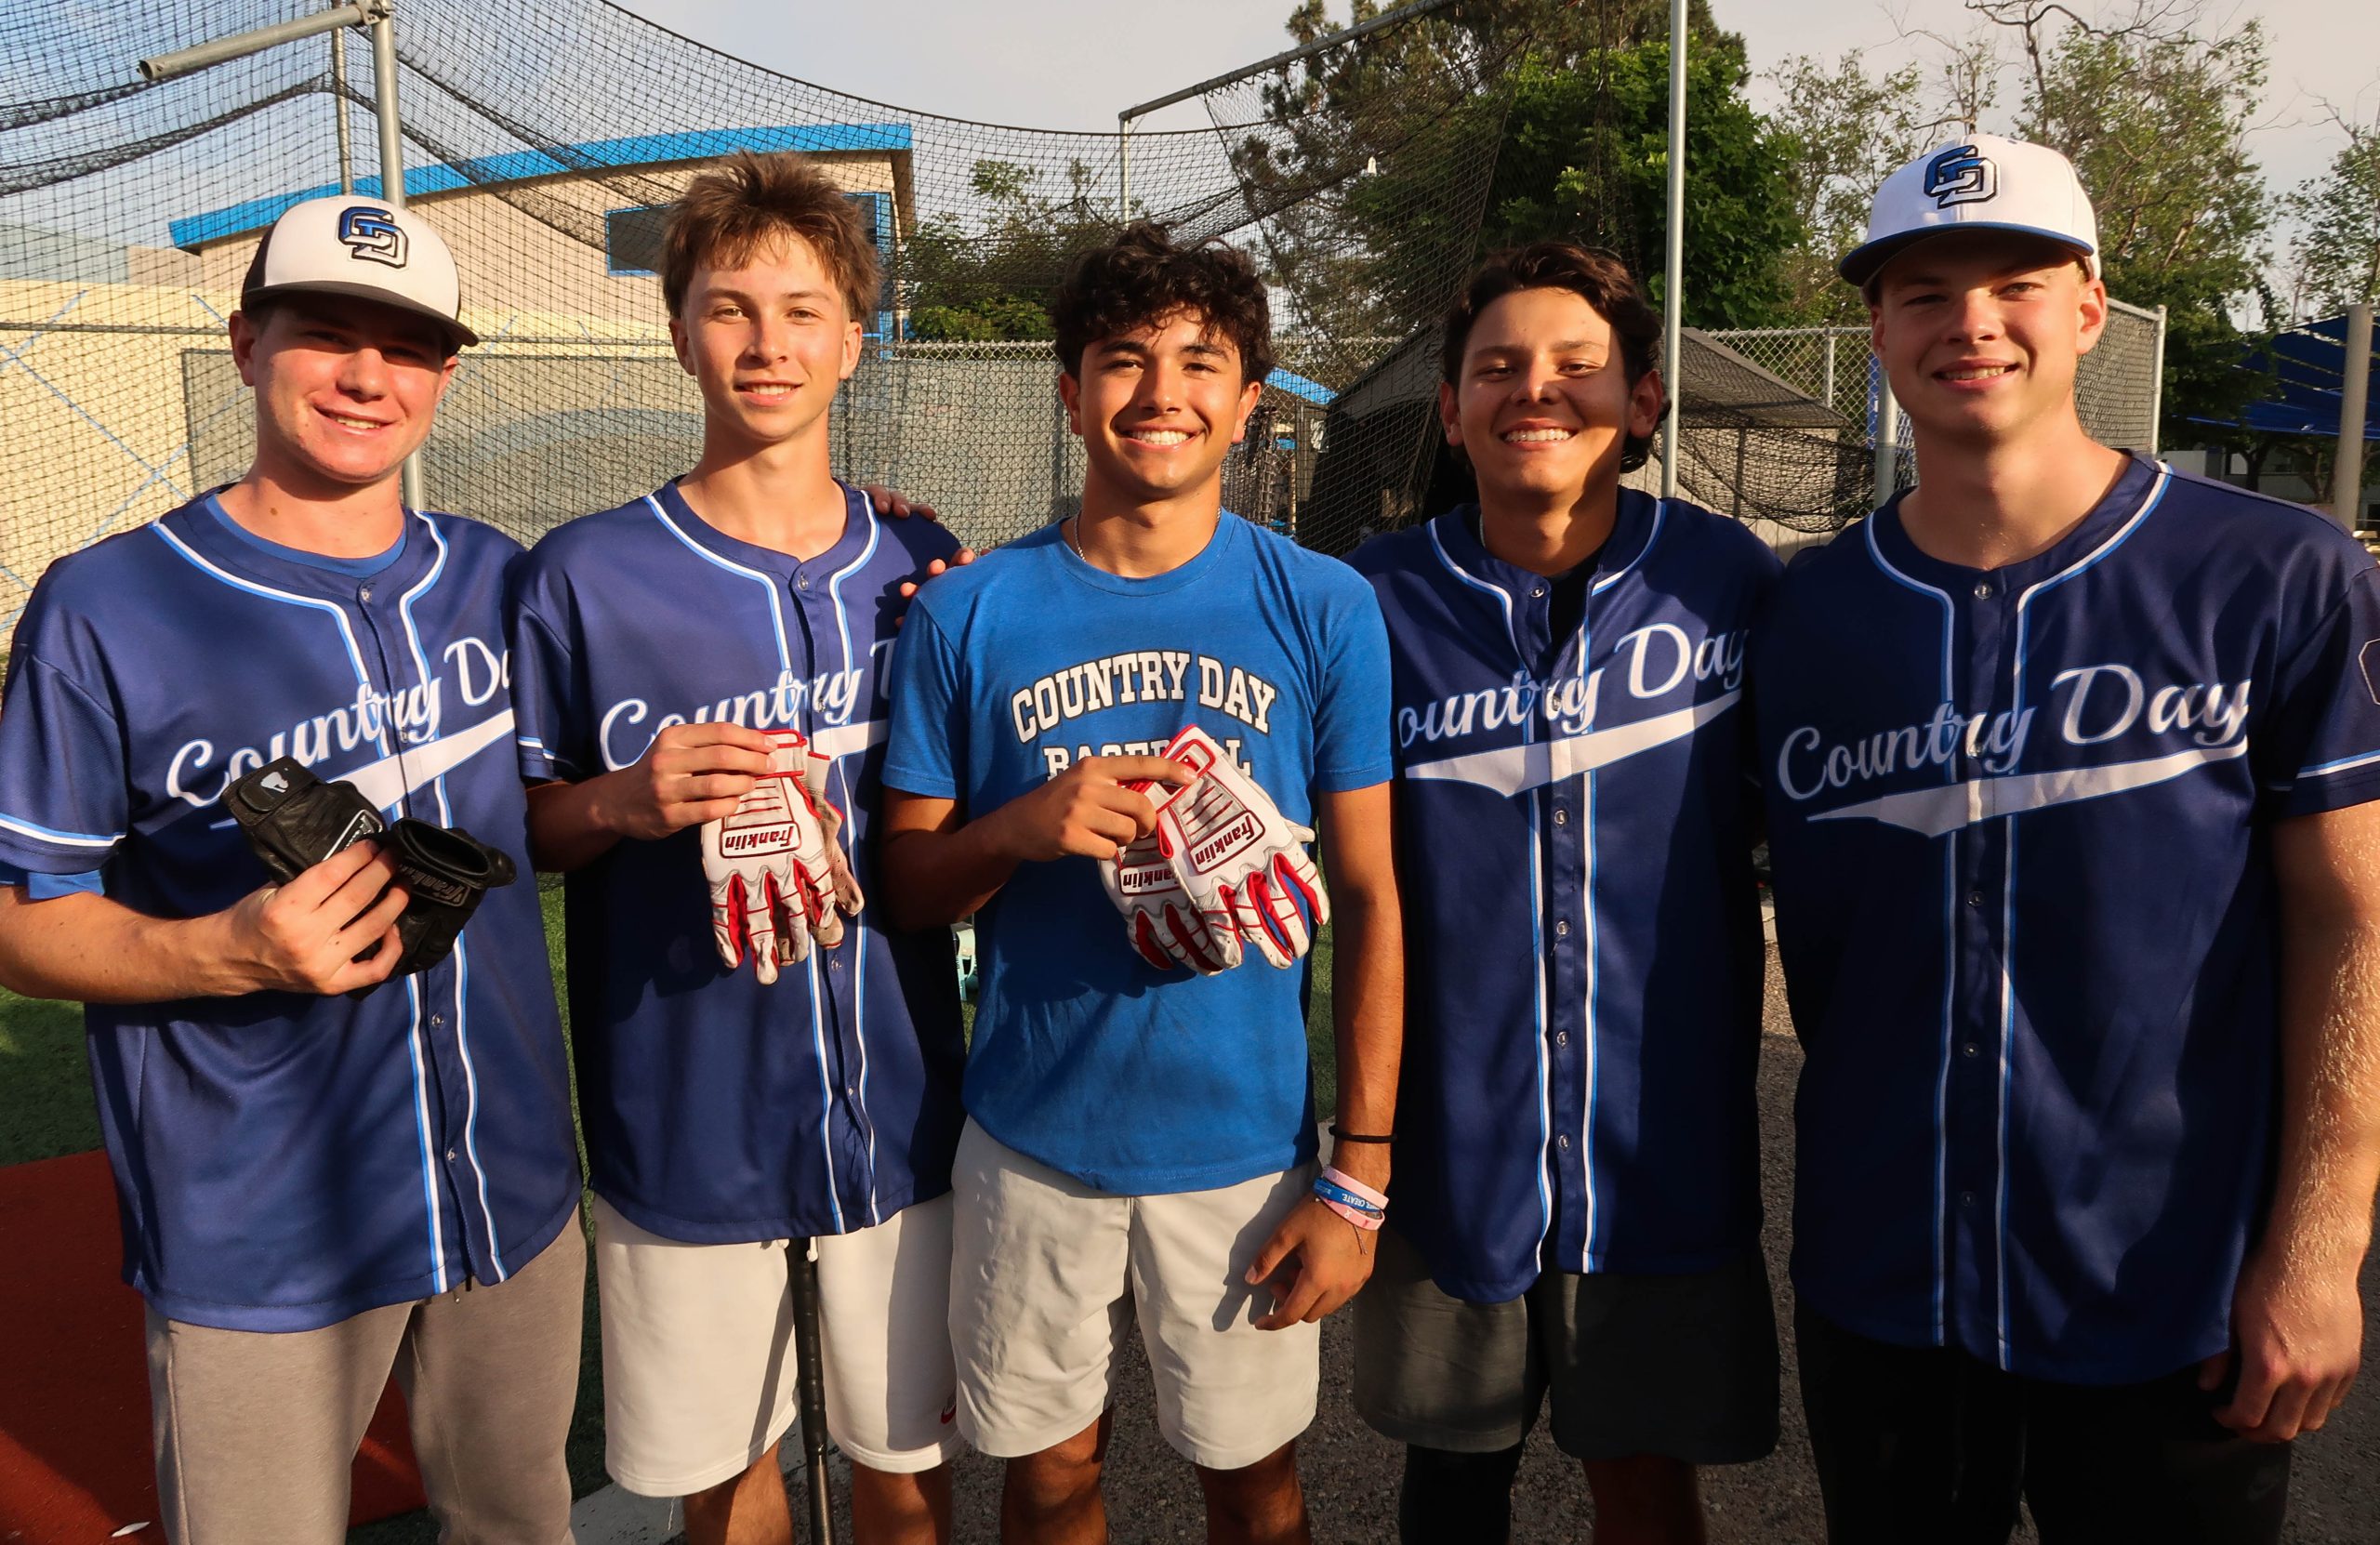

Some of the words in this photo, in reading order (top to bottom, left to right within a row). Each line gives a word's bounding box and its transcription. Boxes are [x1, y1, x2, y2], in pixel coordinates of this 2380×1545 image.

[1012, 651, 1191, 743] COUNTRY
[1198, 655, 1276, 734] DAY
[1397, 667, 1605, 749] ountry
[1616, 623, 1749, 699] Day
[1777, 702, 2037, 799] Country
[2050, 663, 2252, 746] Day
[724, 825, 794, 851] Franklin
[1196, 815, 1255, 865] Franklin
[1123, 868, 1179, 888] anklin
